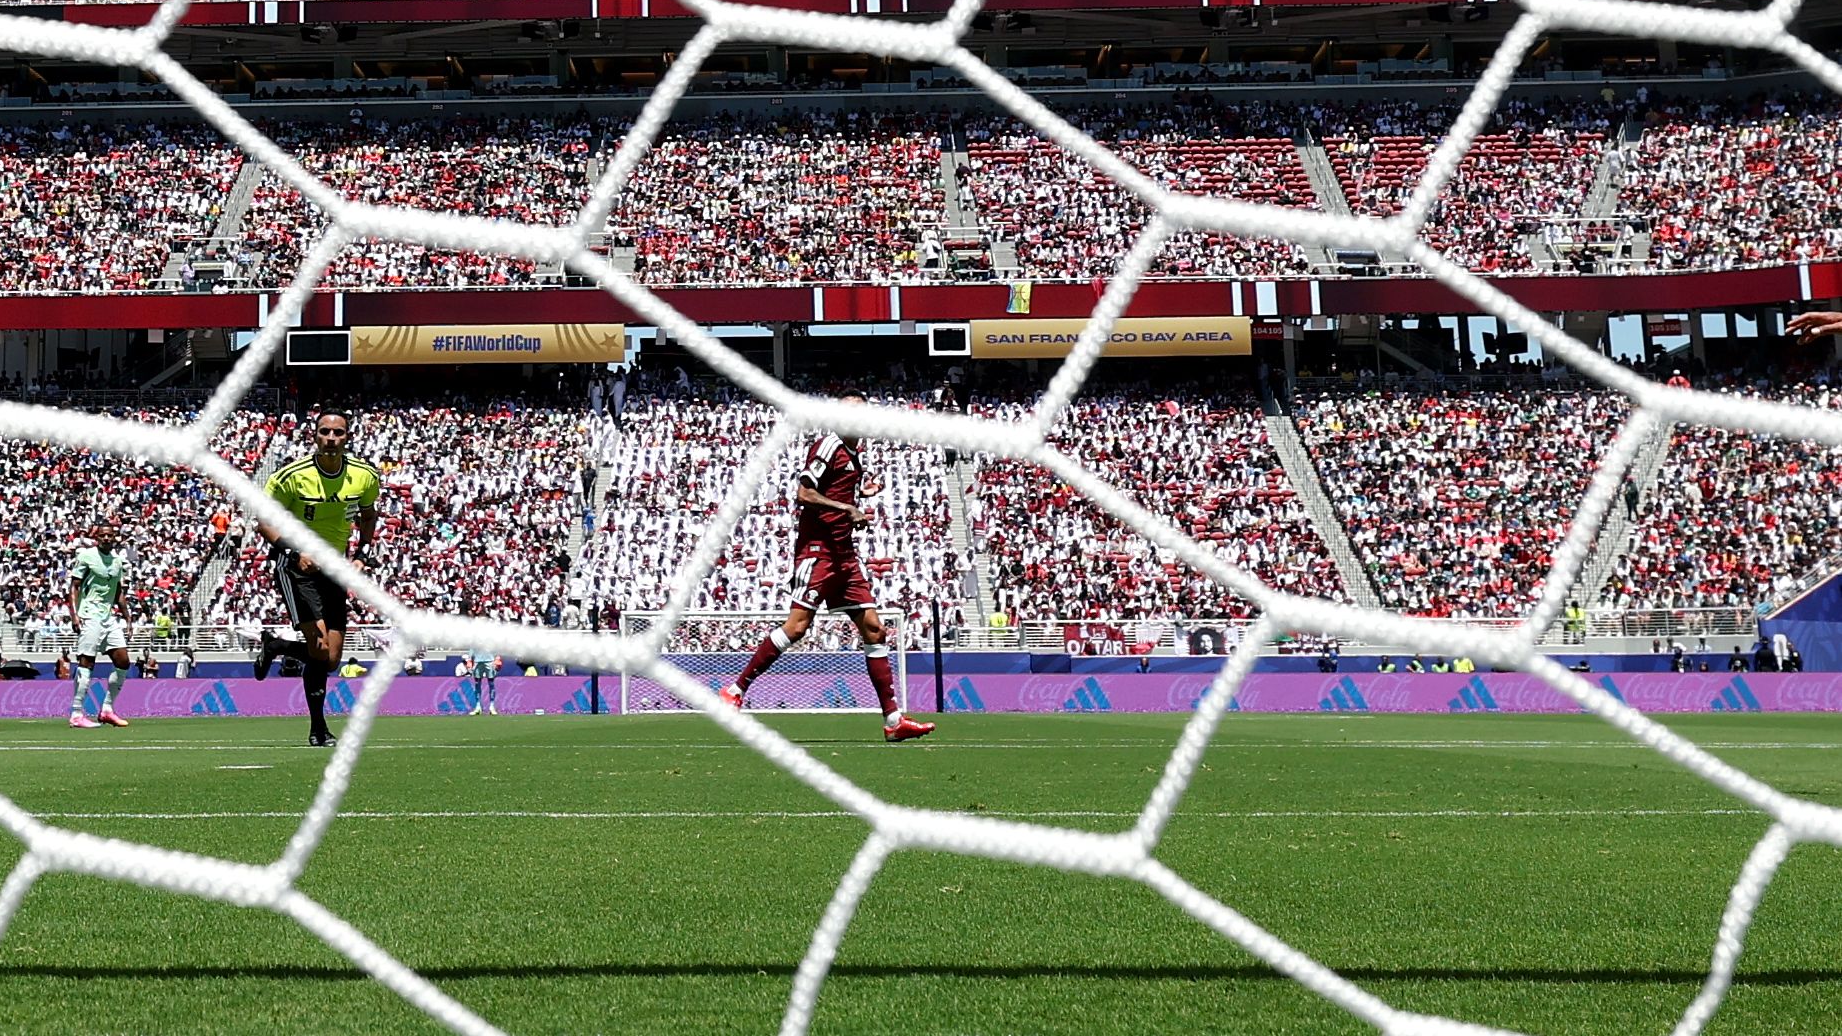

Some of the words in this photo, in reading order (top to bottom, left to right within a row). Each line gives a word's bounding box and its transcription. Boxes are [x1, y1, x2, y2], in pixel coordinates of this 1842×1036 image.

[432, 334, 542, 354] #FIFAWorldCup
[985, 334, 1024, 344] SAN
[1141, 333, 1176, 342] BAY
[1182, 332, 1233, 342] AREA
